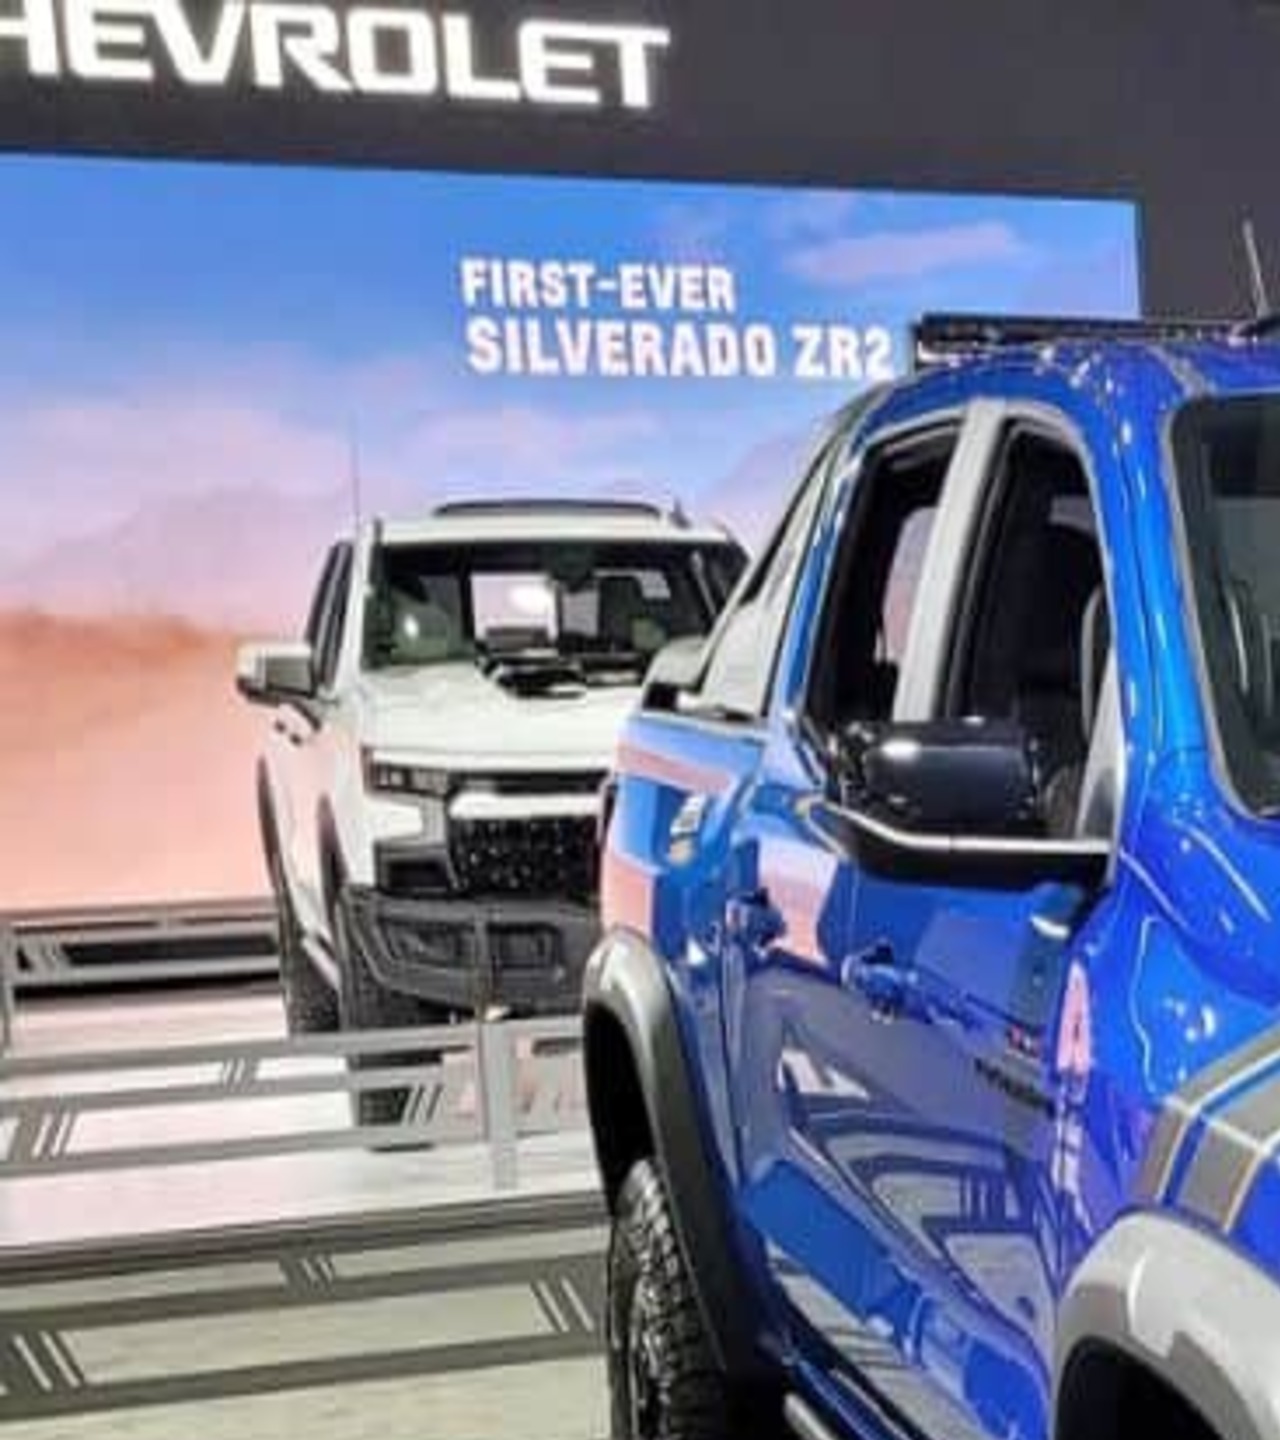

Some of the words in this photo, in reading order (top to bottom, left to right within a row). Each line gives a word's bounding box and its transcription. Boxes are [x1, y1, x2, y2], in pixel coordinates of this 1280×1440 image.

[461, 258, 735, 312] FIRST-EVER
[466, 316, 777, 378] SILVERADO
[793, 324, 895, 381] ZR2
